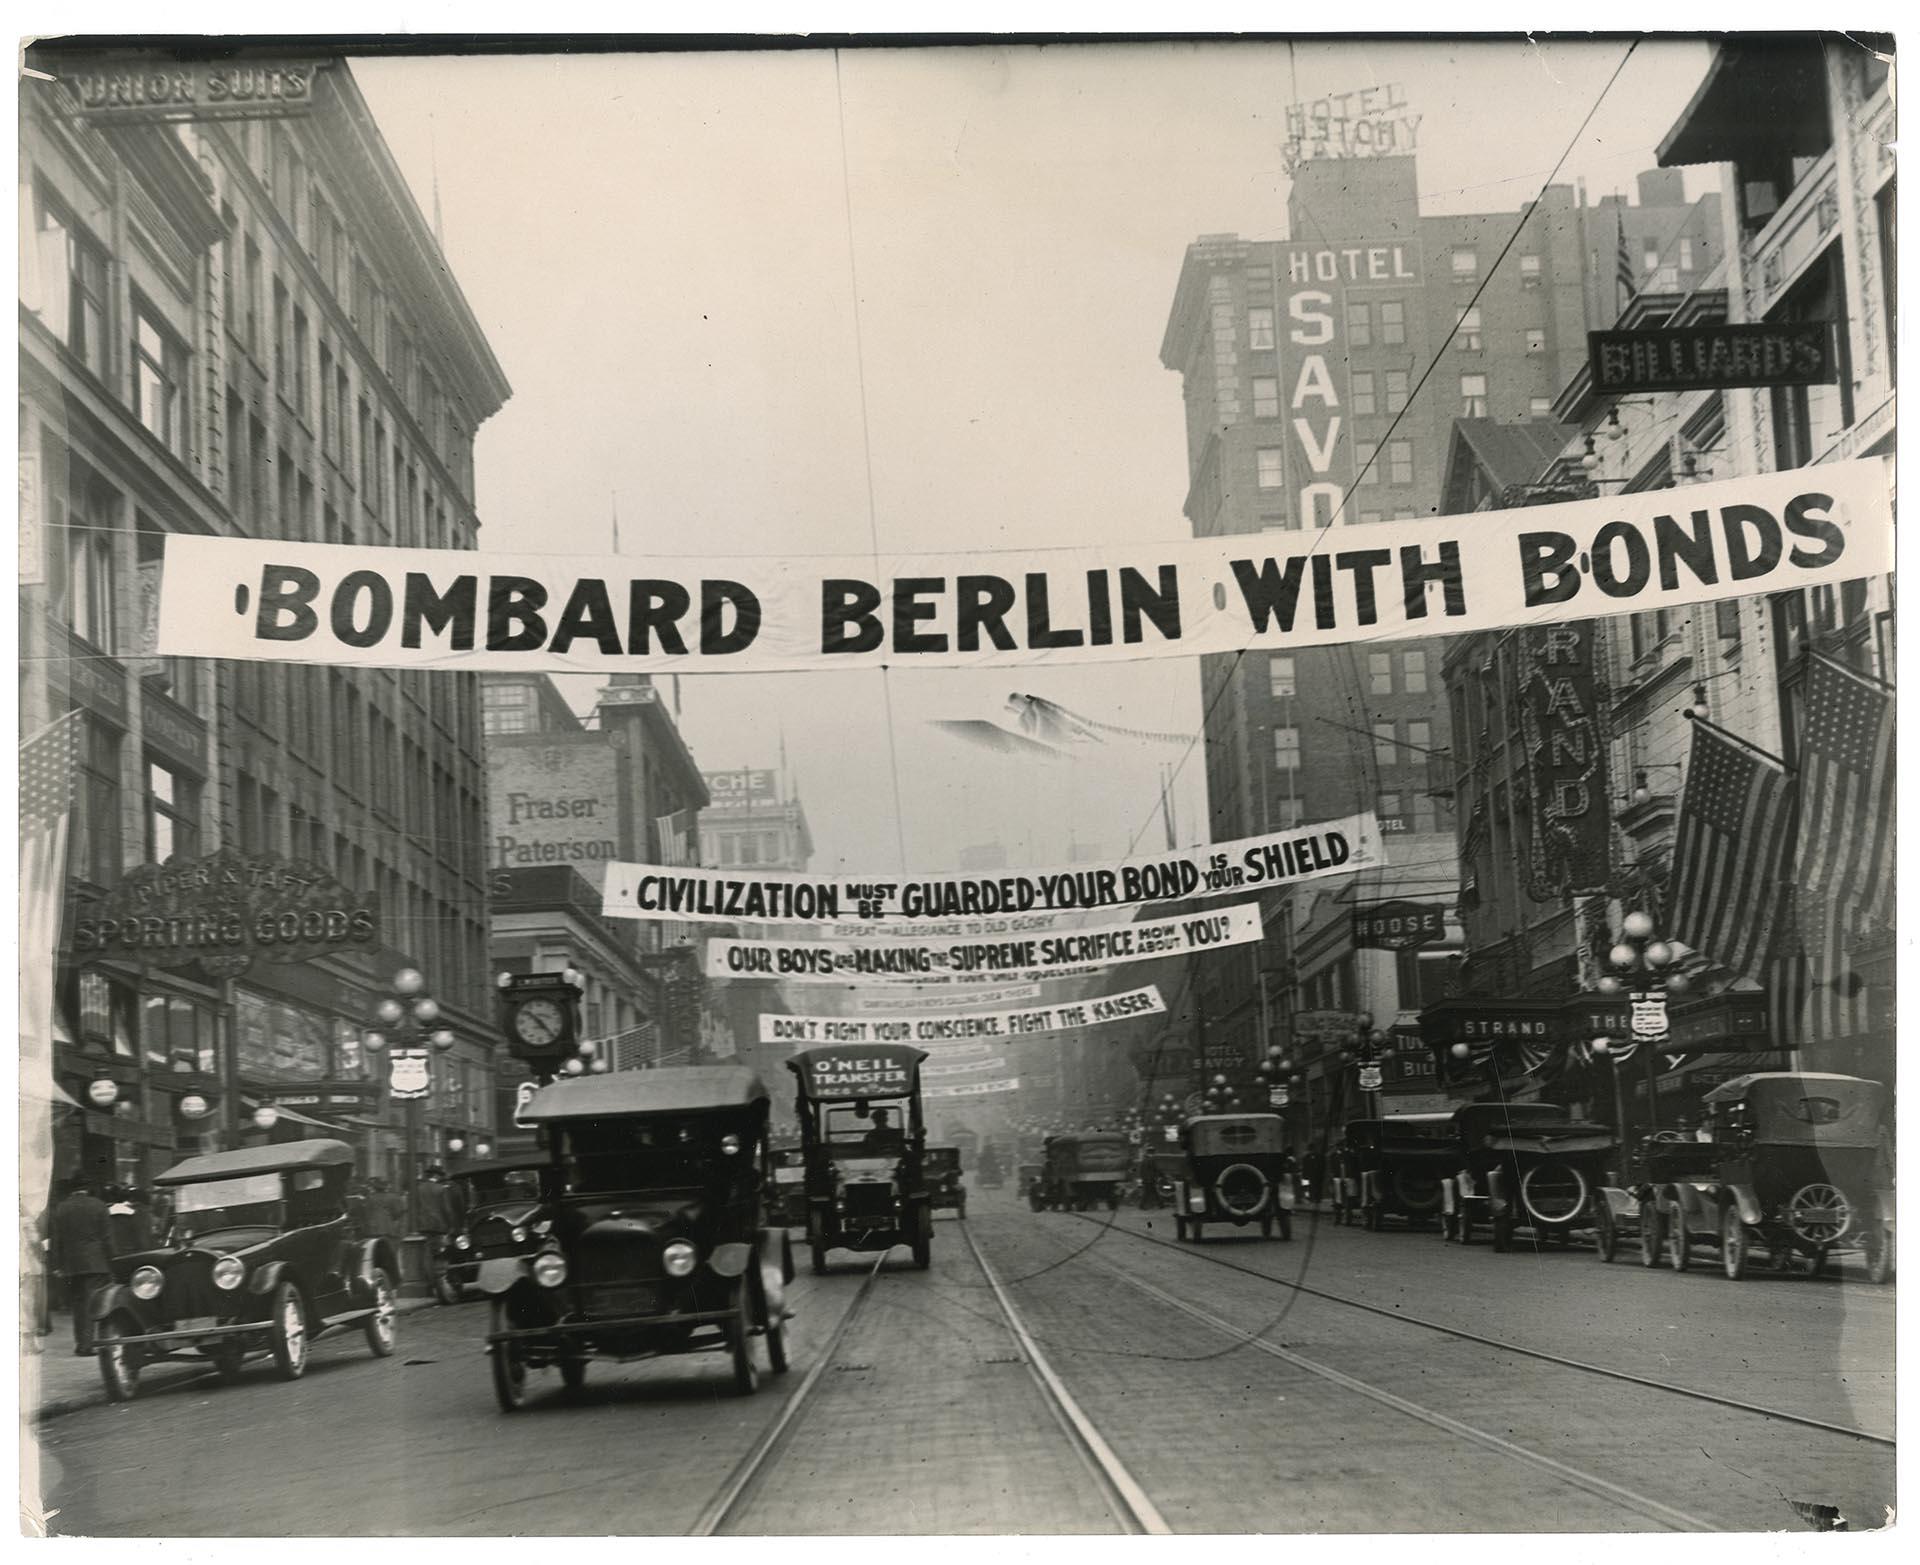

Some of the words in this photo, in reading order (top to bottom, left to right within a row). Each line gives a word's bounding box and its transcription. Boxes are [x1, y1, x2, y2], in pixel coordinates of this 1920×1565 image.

[81, 73, 194, 102] UNION
[207, 69, 307, 100] SUITS
[1289, 247, 1415, 282] HOTEL
[1601, 334, 1822, 384] BILLIARDS
[256, 564, 762, 656] BOMBARD
[822, 564, 1181, 653] BERLIN
[1230, 540, 1467, 633] WITH
[1518, 492, 1846, 607] BONDS
[496, 835, 617, 868] Paterson
[1210, 853, 1228, 870] IS
[1244, 832, 1350, 884] SHIELD
[846, 883, 898, 900] MUST
[1121, 859, 1199, 901] BOND
[1200, 866, 1245, 891] YOUR
[637, 875, 838, 919] CIVILIZATION
[858, 900, 885, 919] BE
[75, 912, 242, 946] SPORTING
[255, 909, 374, 945] GOODS
[834, 925, 877, 937] REPEAT
[893, 924, 961, 937] ALLEGIANCE
[966, 922, 983, 935] TO
[984, 920, 1008, 933] OLD
[1011, 915, 1055, 931] GLORY
[1138, 924, 1176, 941] HOW
[1182, 915, 1231, 947] YOU?
[949, 941, 1038, 971] SUPREME
[1040, 930, 1132, 966] SACRIFICE
[1137, 937, 1181, 954] ABOUT
[728, 946, 772, 973] OUR
[778, 948, 834, 974] BOYS
[855, 947, 931, 974] MAKING
[774, 1018, 818, 1040] DON'T
[824, 1022, 867, 1041] FIGHT
[872, 1022, 912, 1041] YOUR
[1008, 1011, 1052, 1033] FIGHT
[1057, 1006, 1087, 1027] THE
[1464, 1021, 1547, 1035] STRAND
[1589, 1015, 1628, 1029] THE
[812, 1070, 907, 1085] TRANSFER
[815, 1057, 901, 1072] O'NEIL
